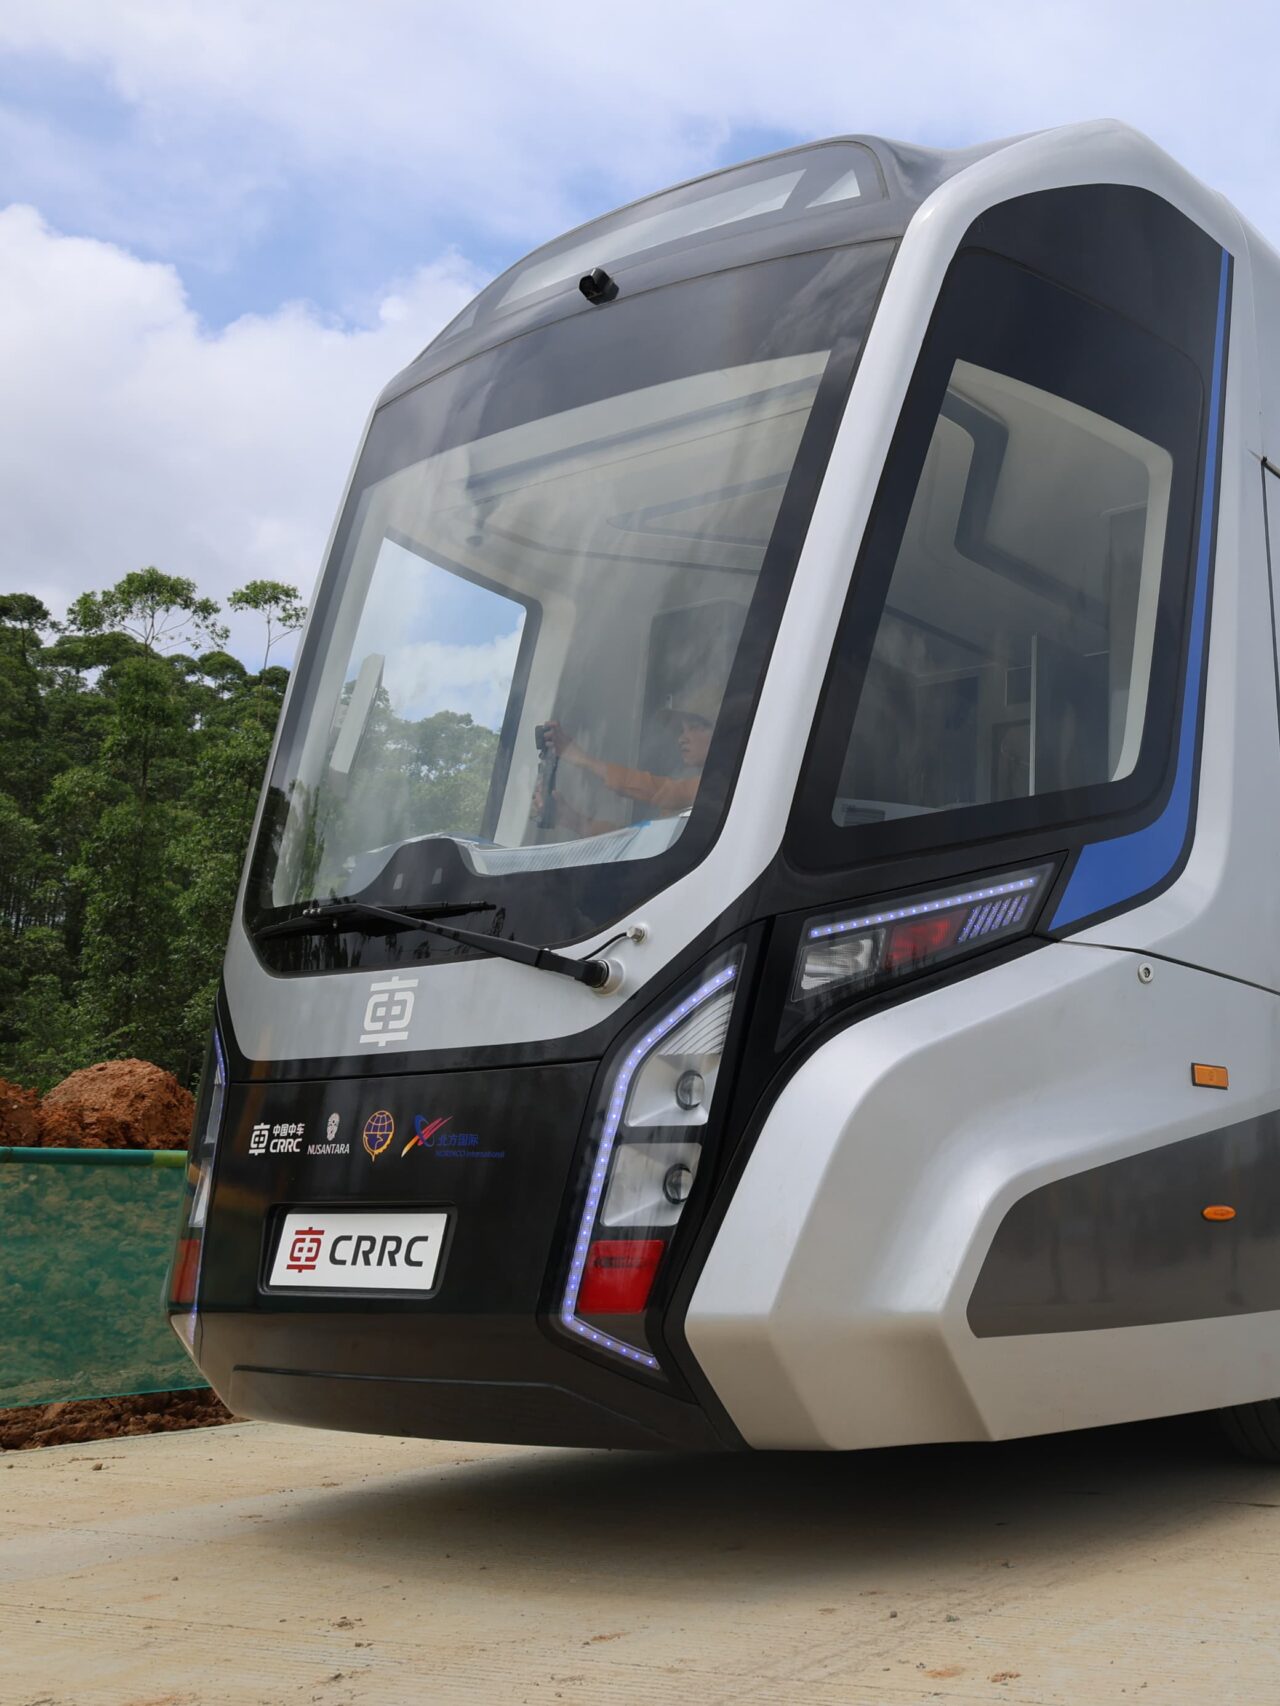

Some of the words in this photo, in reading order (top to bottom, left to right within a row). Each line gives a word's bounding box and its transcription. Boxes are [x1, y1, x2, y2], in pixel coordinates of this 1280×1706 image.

[273, 1122, 306, 1137] 中国中车
[269, 1138, 303, 1153] CRRC
[307, 1143, 350, 1155] NUSANTARA
[329, 1235, 428, 1267] CRRC
